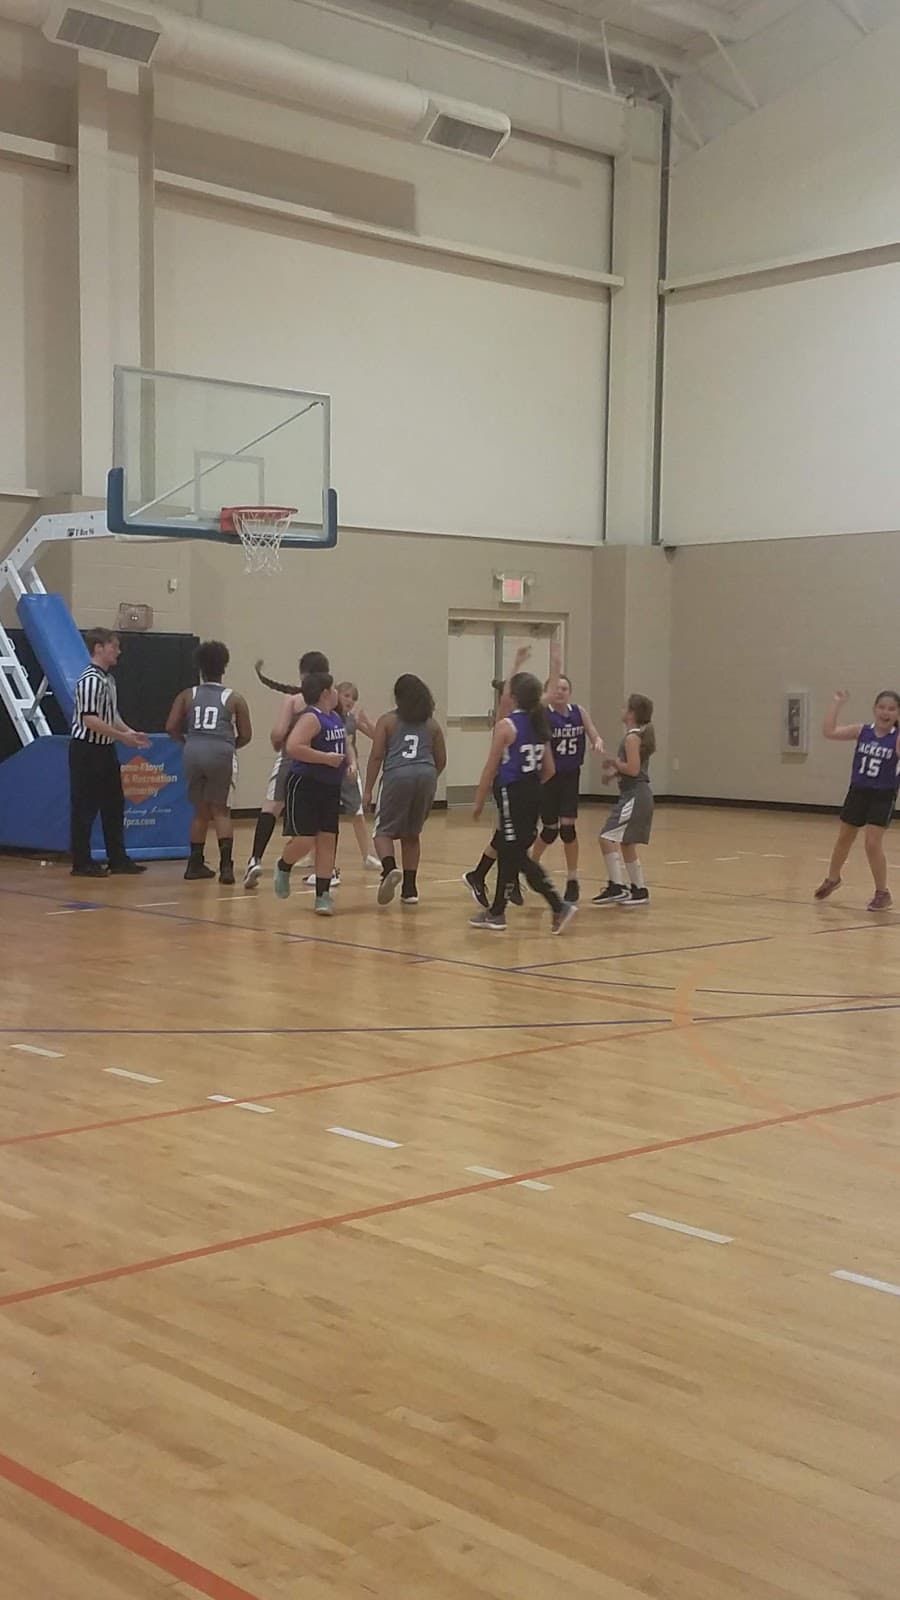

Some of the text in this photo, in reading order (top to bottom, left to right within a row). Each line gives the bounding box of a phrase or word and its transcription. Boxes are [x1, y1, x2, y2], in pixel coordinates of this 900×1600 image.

[194, 705, 219, 729] 10
[552, 726, 584, 738] JACKETS
[402, 734, 419, 758] 3
[556, 738, 577, 755] 45
[859, 756, 882, 777] 15
